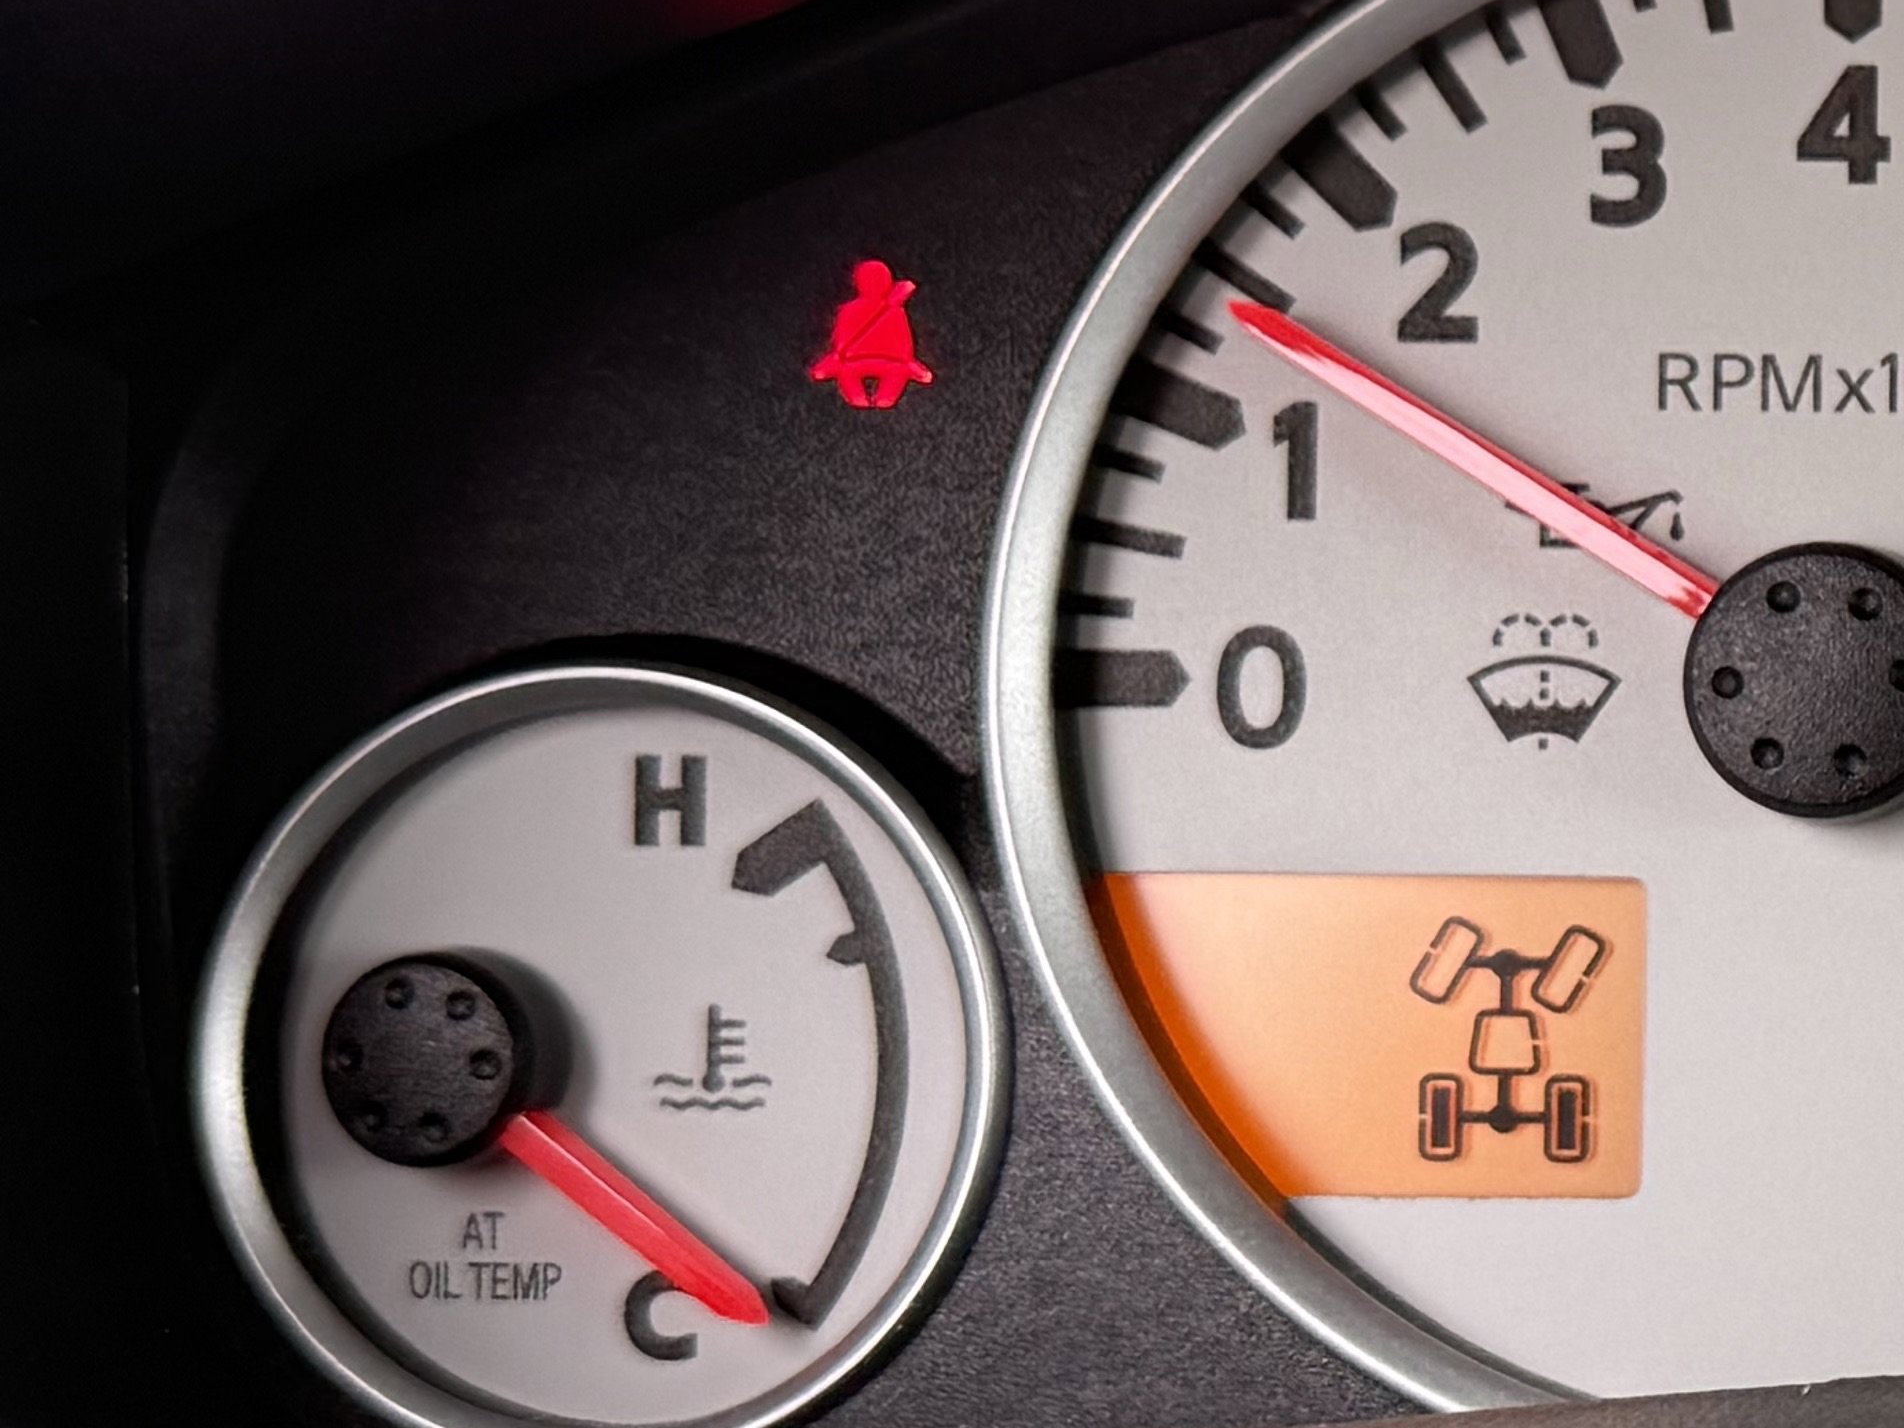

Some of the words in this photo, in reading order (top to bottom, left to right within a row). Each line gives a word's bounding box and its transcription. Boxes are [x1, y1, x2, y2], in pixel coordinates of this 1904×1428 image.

[1590, 104, 1668, 228] 3
[1796, 65, 1891, 185] 4
[1398, 221, 1479, 343] 2
[1272, 401, 1319, 521] 1
[1216, 624, 1308, 750] 0
[635, 755, 707, 846] H
[410, 1261, 467, 1300] OIL
[470, 1261, 562, 1301] TEMP
[462, 1213, 505, 1250] AT
[624, 1270, 698, 1361] C
